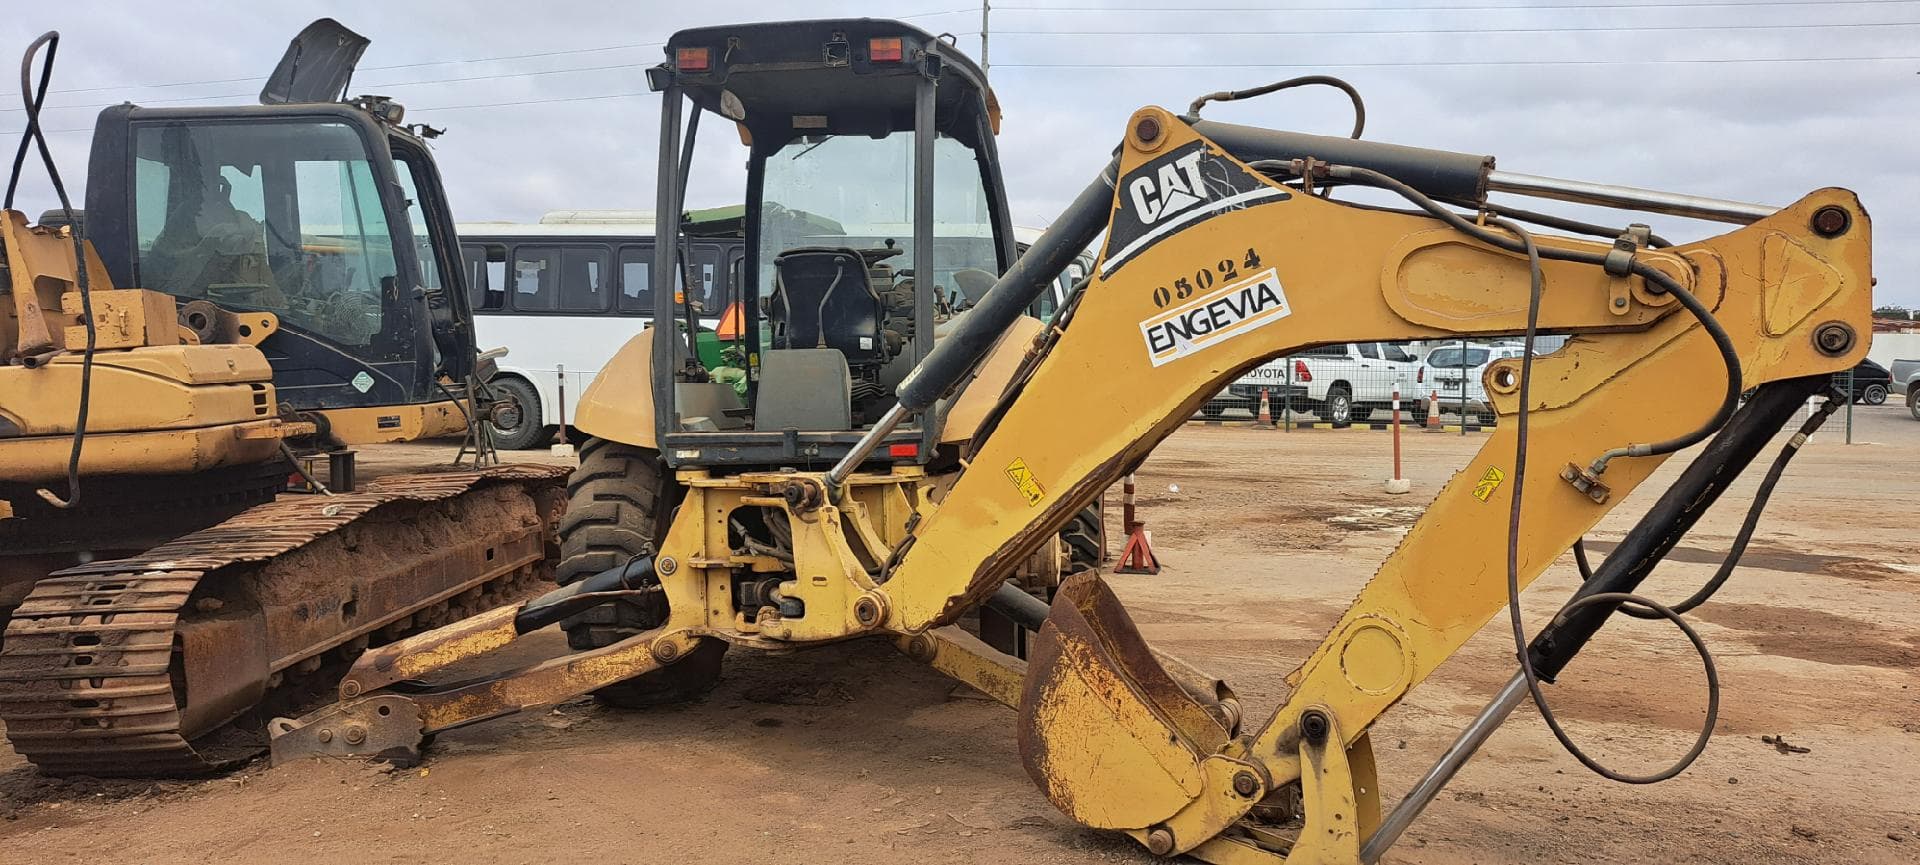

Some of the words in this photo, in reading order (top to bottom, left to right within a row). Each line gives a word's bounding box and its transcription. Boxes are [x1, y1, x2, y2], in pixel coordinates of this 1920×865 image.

[1129, 150, 1208, 225] CAT
[1153, 248, 1261, 308] 05024
[1147, 283, 1281, 353] ENGEVIA
